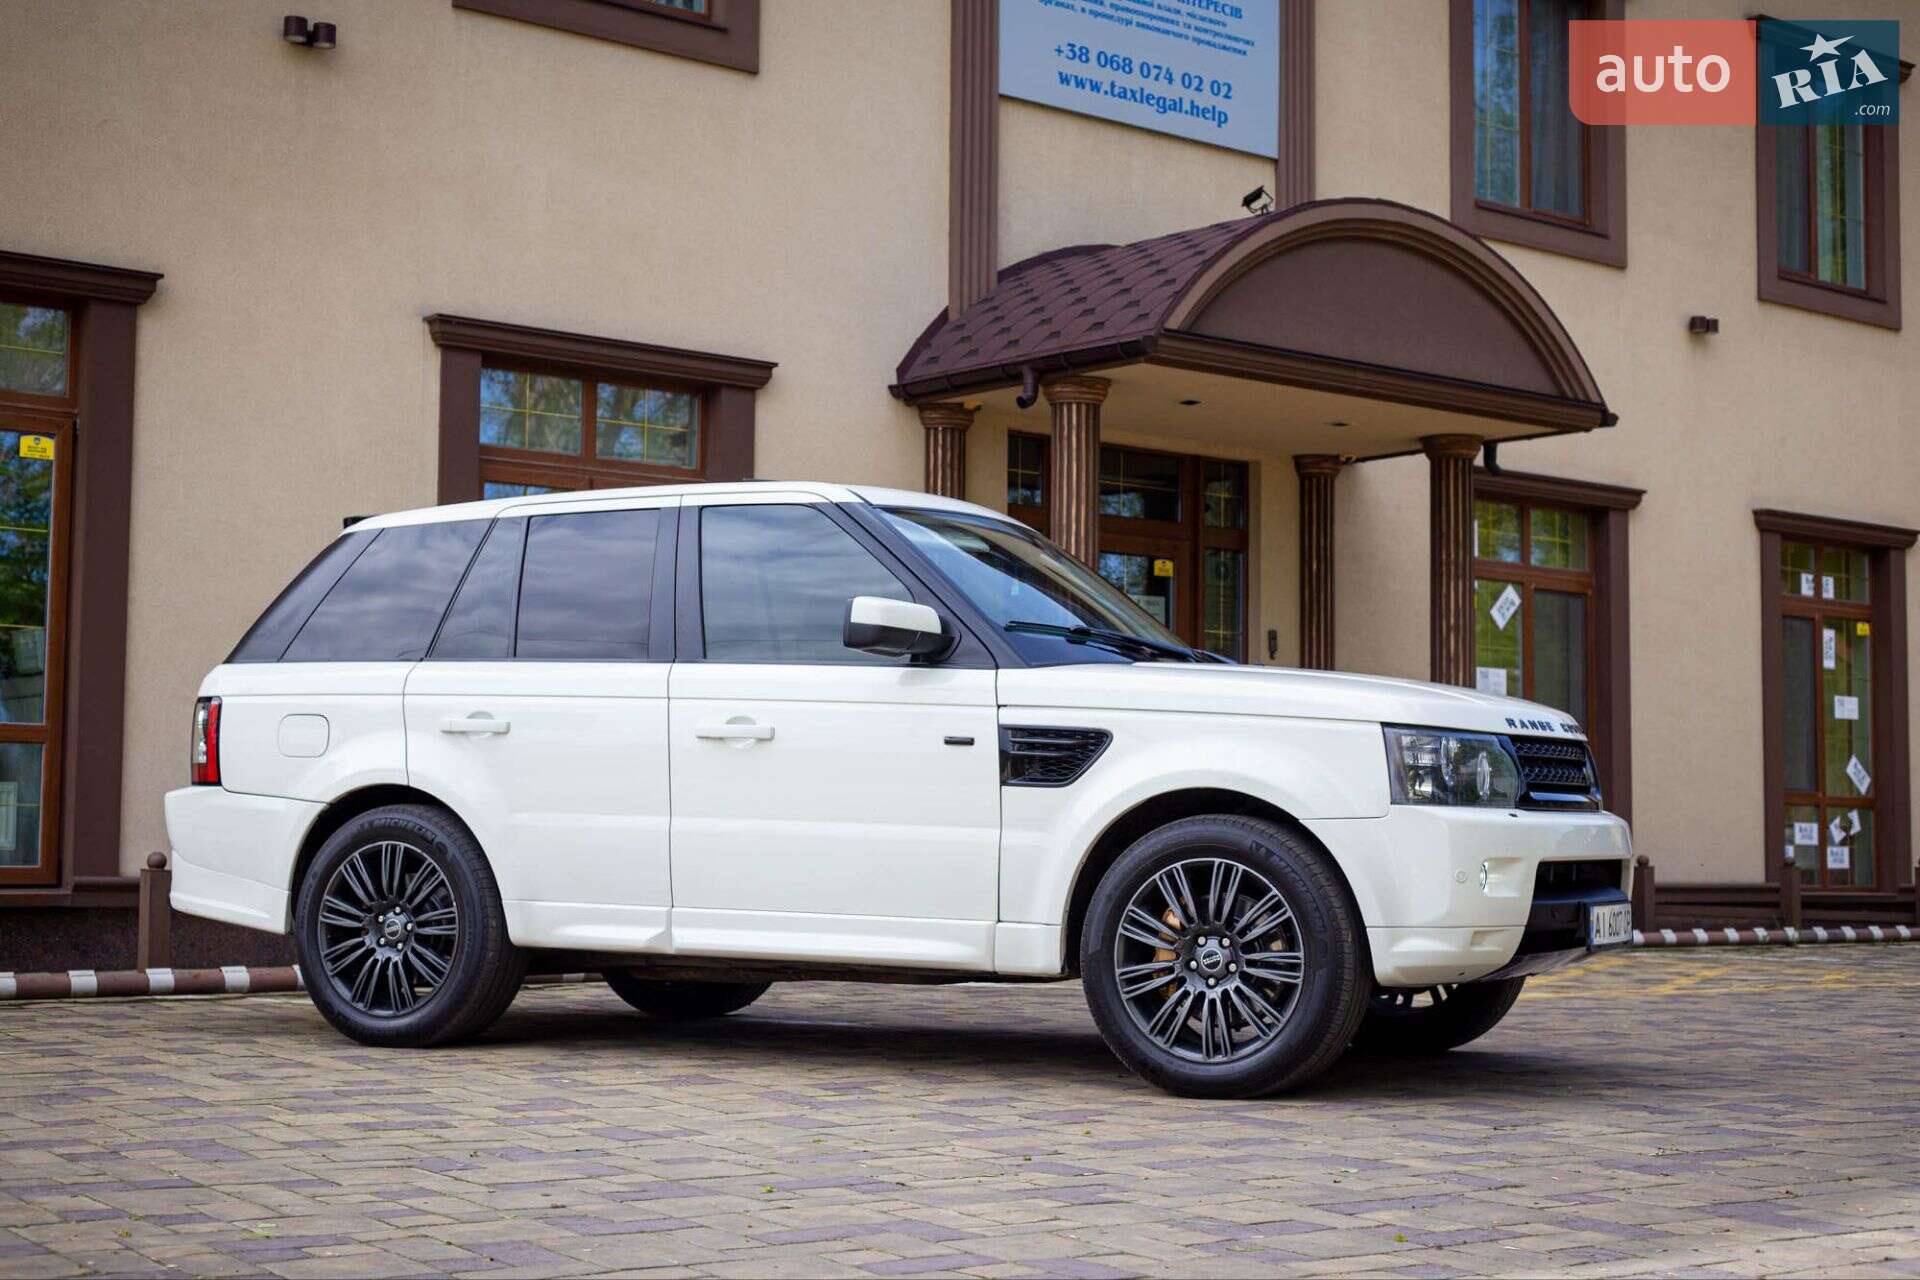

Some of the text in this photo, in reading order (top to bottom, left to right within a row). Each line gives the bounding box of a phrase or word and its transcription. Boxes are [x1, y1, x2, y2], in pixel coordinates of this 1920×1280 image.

[1054, 42, 1233, 100] +38 068 074 02 02
[1058, 70, 1229, 127] www.taxlegal.help
[1505, 717, 1554, 732] RANGE
